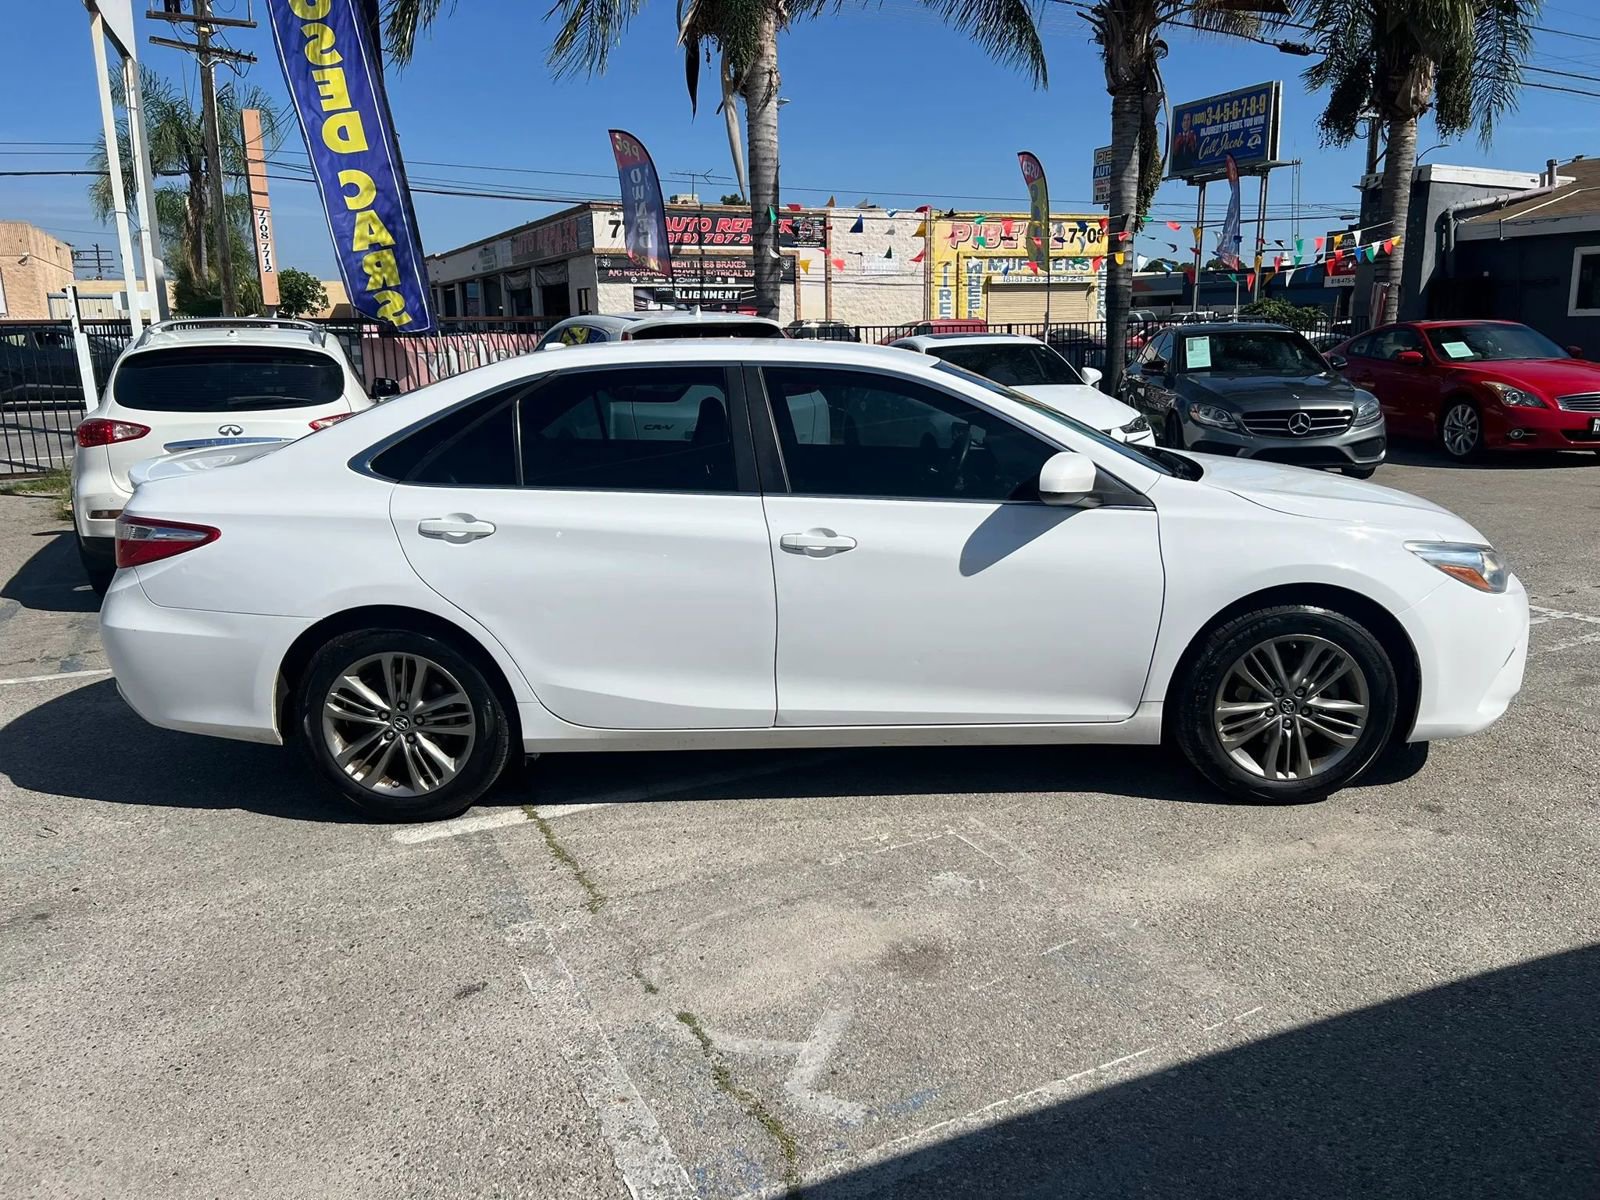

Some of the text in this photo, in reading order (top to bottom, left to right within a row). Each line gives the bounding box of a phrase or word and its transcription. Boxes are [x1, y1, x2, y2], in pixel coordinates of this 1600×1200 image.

[257, 209, 269, 240] 7708
[261, 243, 273, 273] 7712
[716, 260, 747, 269] BRAKES
[675, 290, 740, 299] ALIGNMENT
